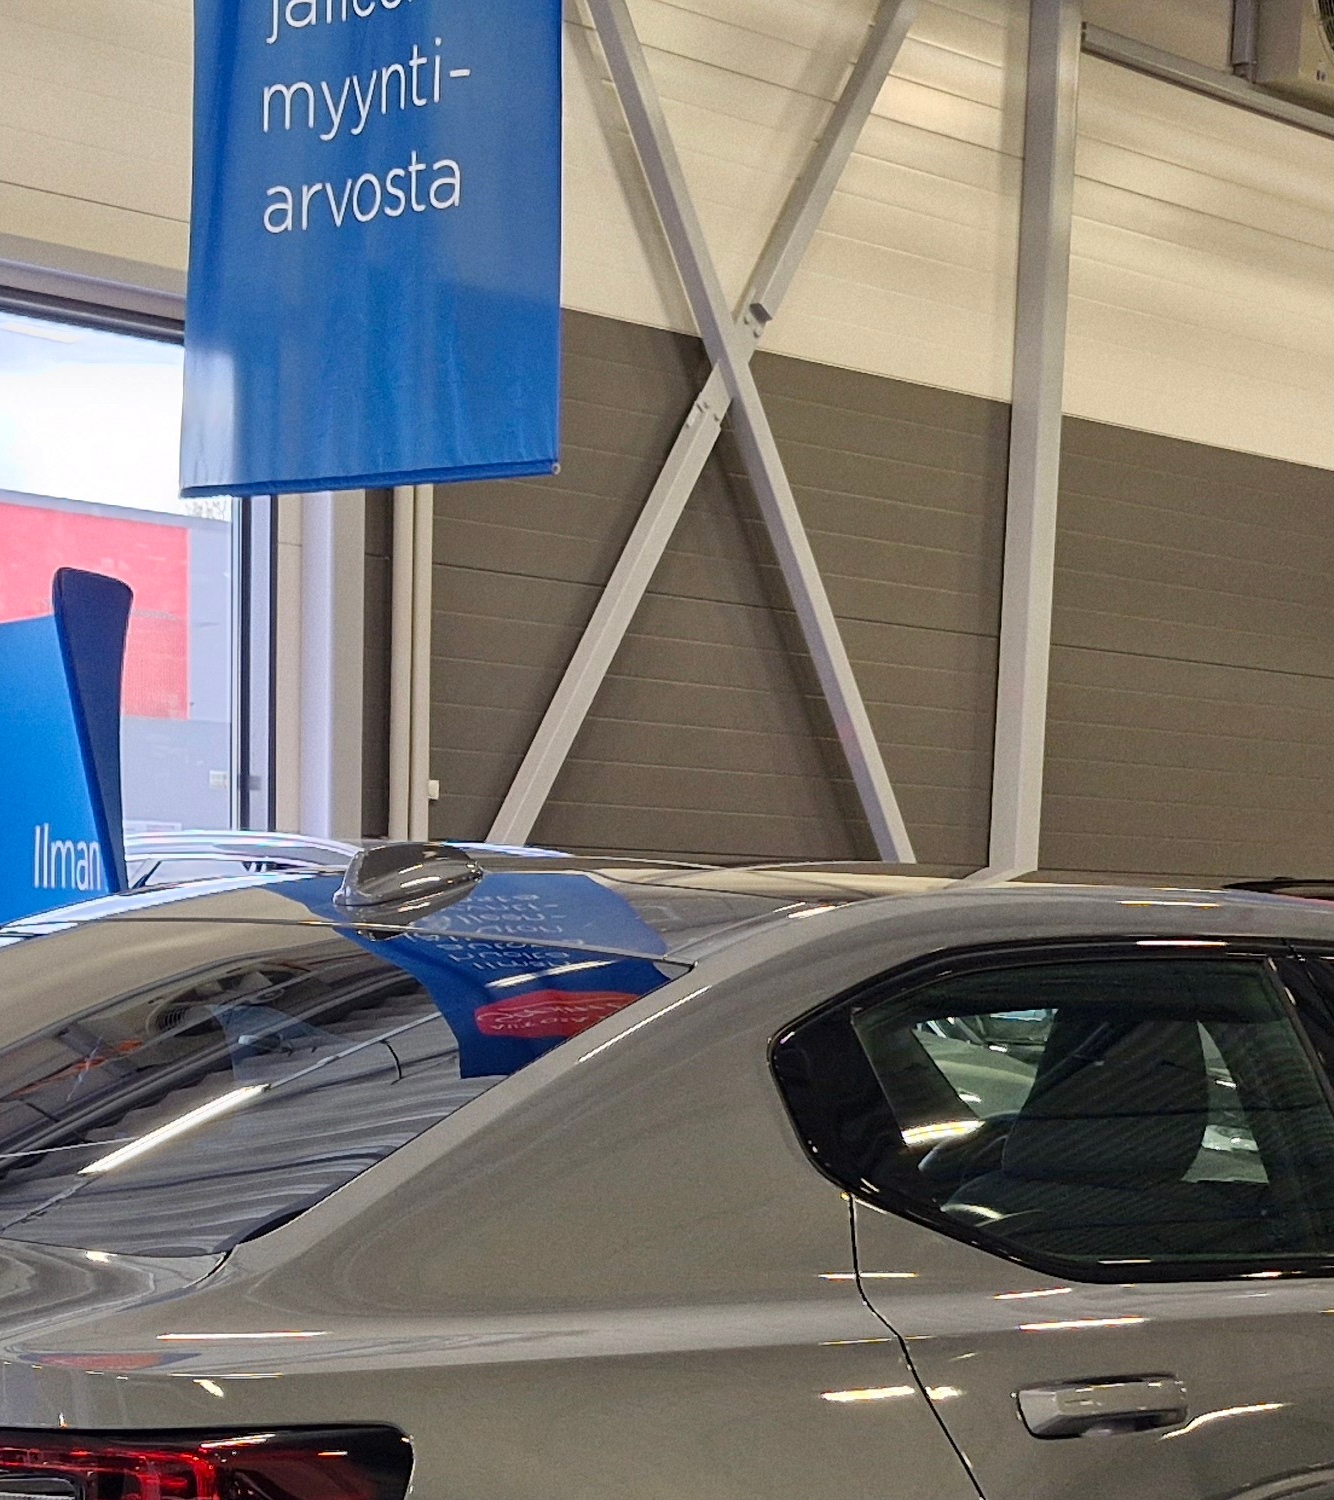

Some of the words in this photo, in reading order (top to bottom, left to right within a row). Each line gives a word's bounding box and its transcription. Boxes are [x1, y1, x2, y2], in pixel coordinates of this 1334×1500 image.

[263, 37, 471, 141] myynti-
[263, 150, 461, 234] arvosta
[34, 822, 101, 891] Ilman
